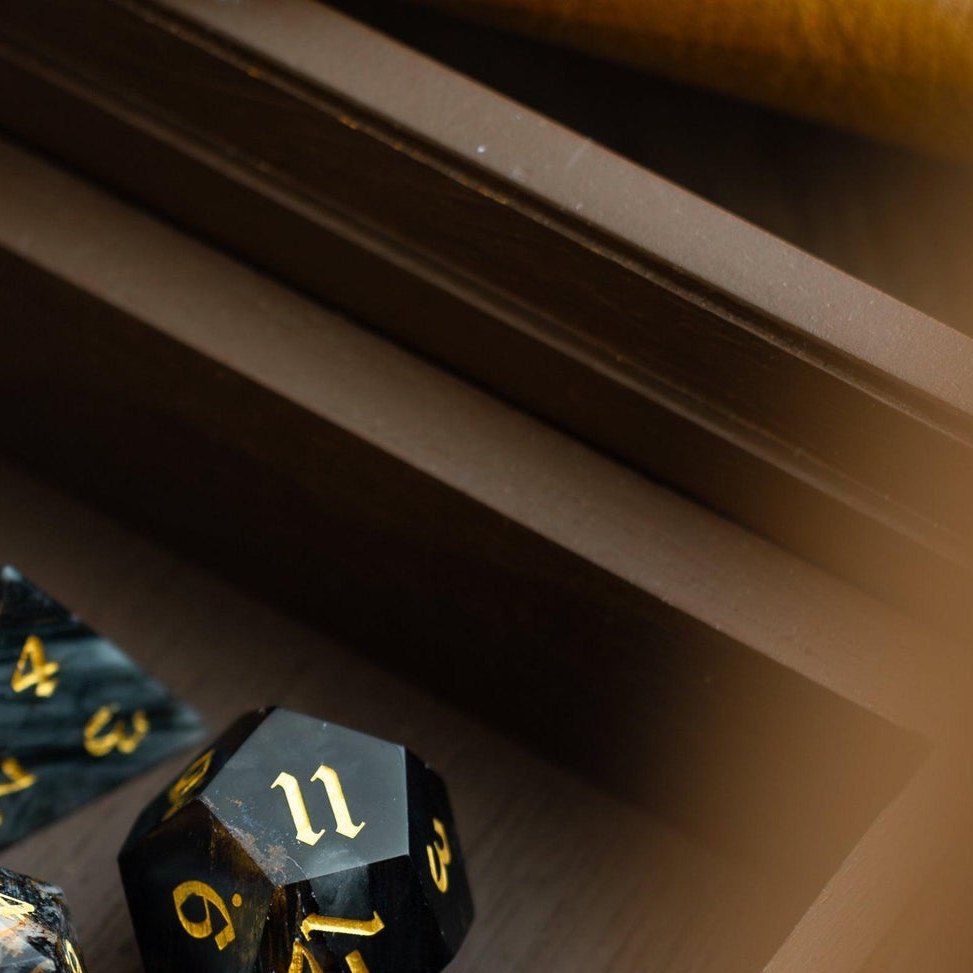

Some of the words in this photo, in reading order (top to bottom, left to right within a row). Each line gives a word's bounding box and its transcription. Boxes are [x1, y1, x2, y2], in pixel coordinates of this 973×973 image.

[11, 635, 60, 697] 4
[83, 704, 149, 757] 3
[270, 764, 366, 846] 11
